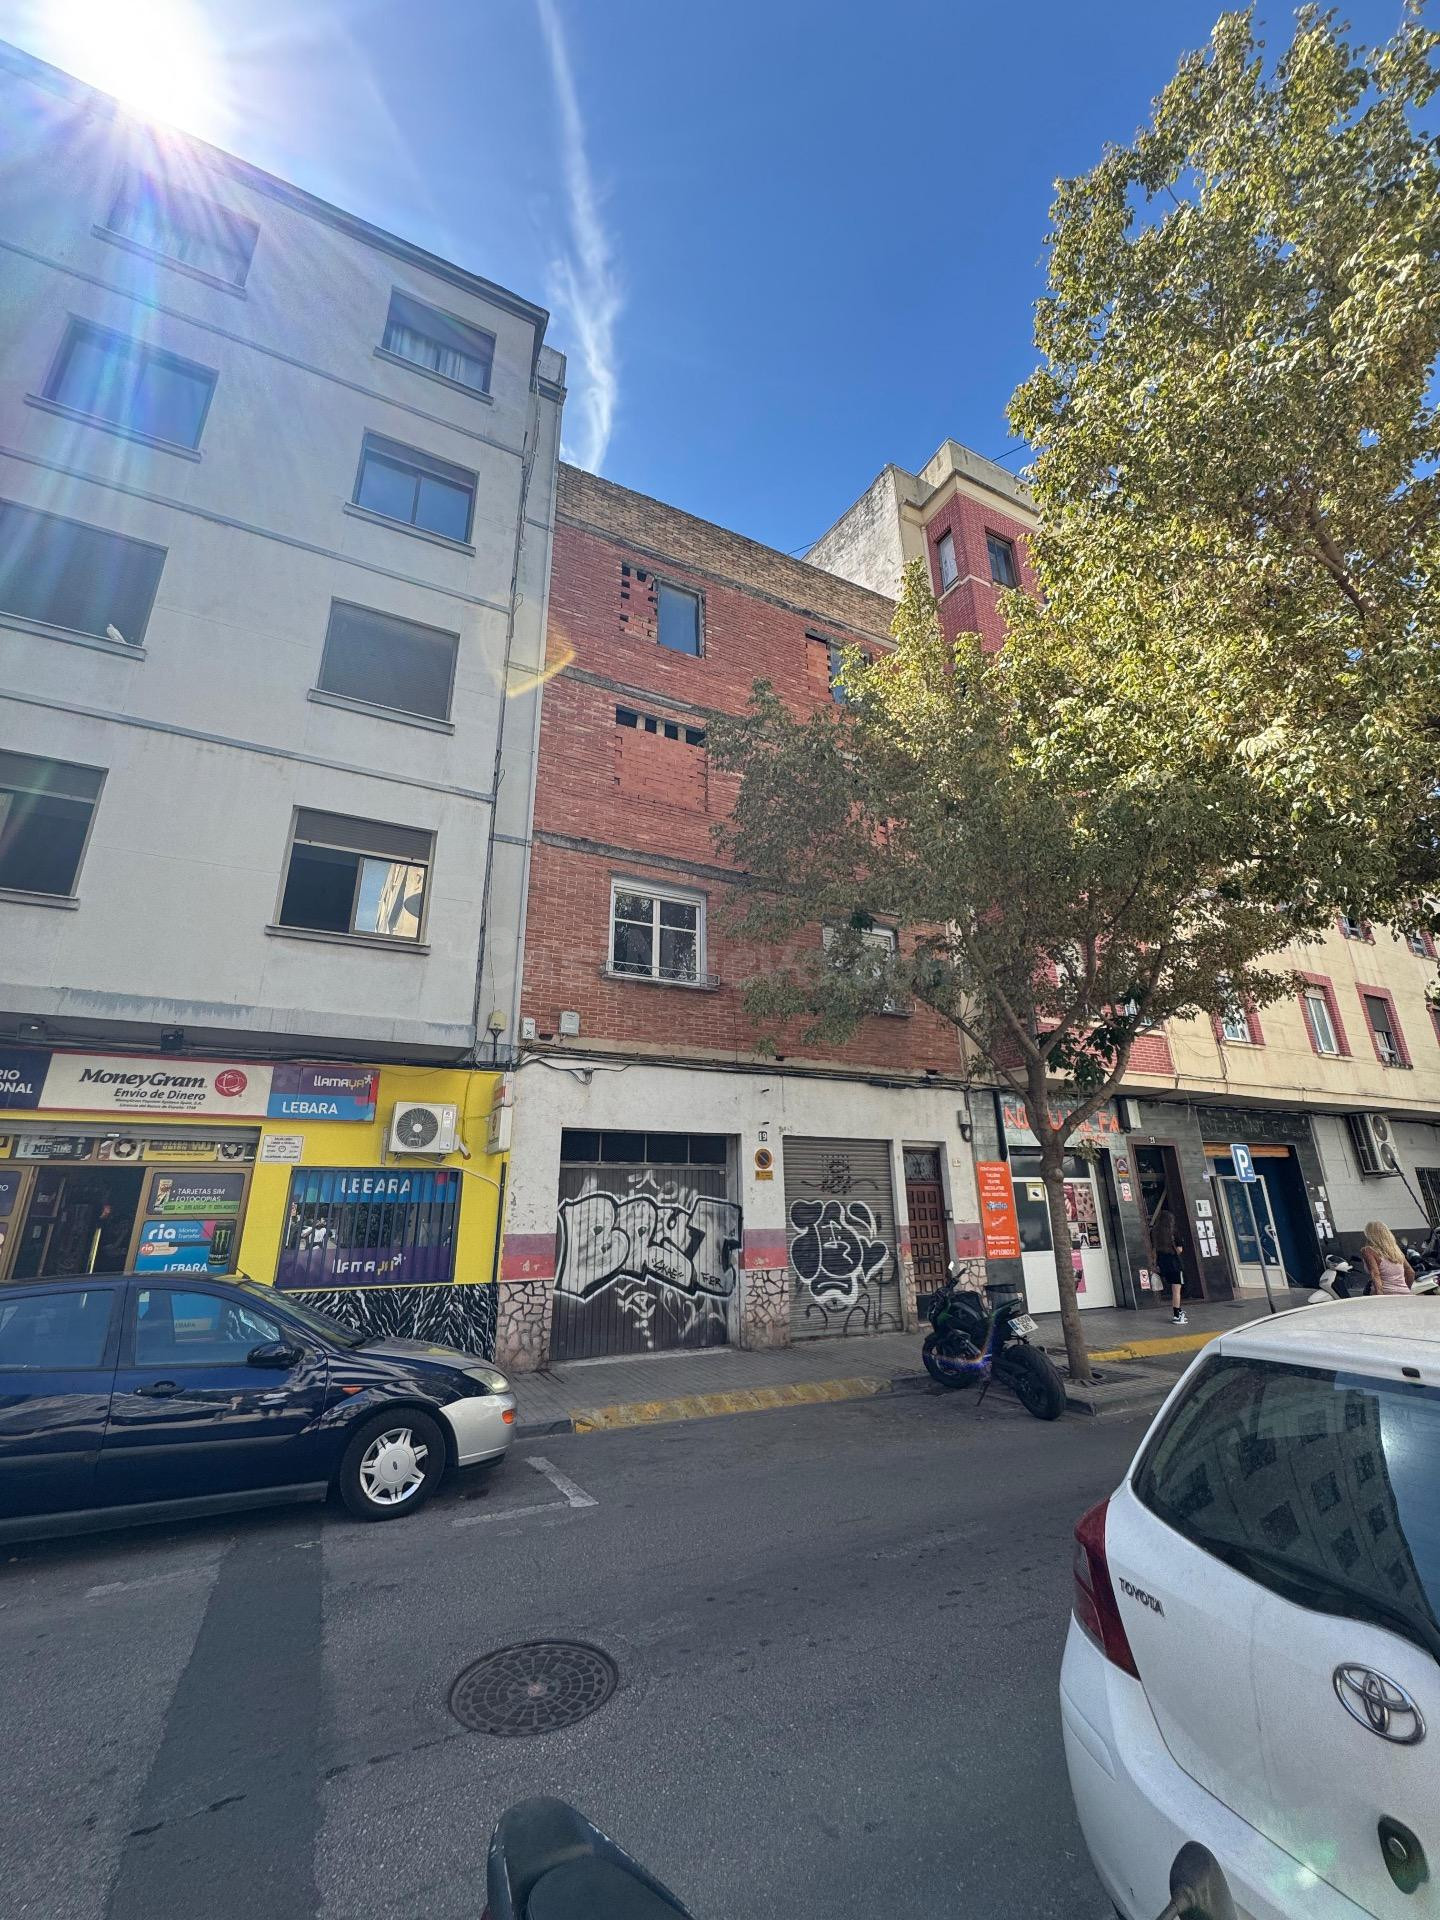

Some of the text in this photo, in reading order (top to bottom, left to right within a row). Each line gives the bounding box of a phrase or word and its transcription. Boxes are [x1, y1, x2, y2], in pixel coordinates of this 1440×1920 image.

[79, 1068, 206, 1088] MoneyGram
[149, 1089, 165, 1099] de
[166, 1090, 206, 1101] Dinero
[282, 1101, 338, 1114] LEBARA
[759, 1132, 767, 1140] 19
[1235, 1148, 1249, 1178] P
[148, 1223, 176, 1240] ria
[141, 1242, 154, 1251] ria
[1119, 1577, 1165, 1618] TOYOTA
